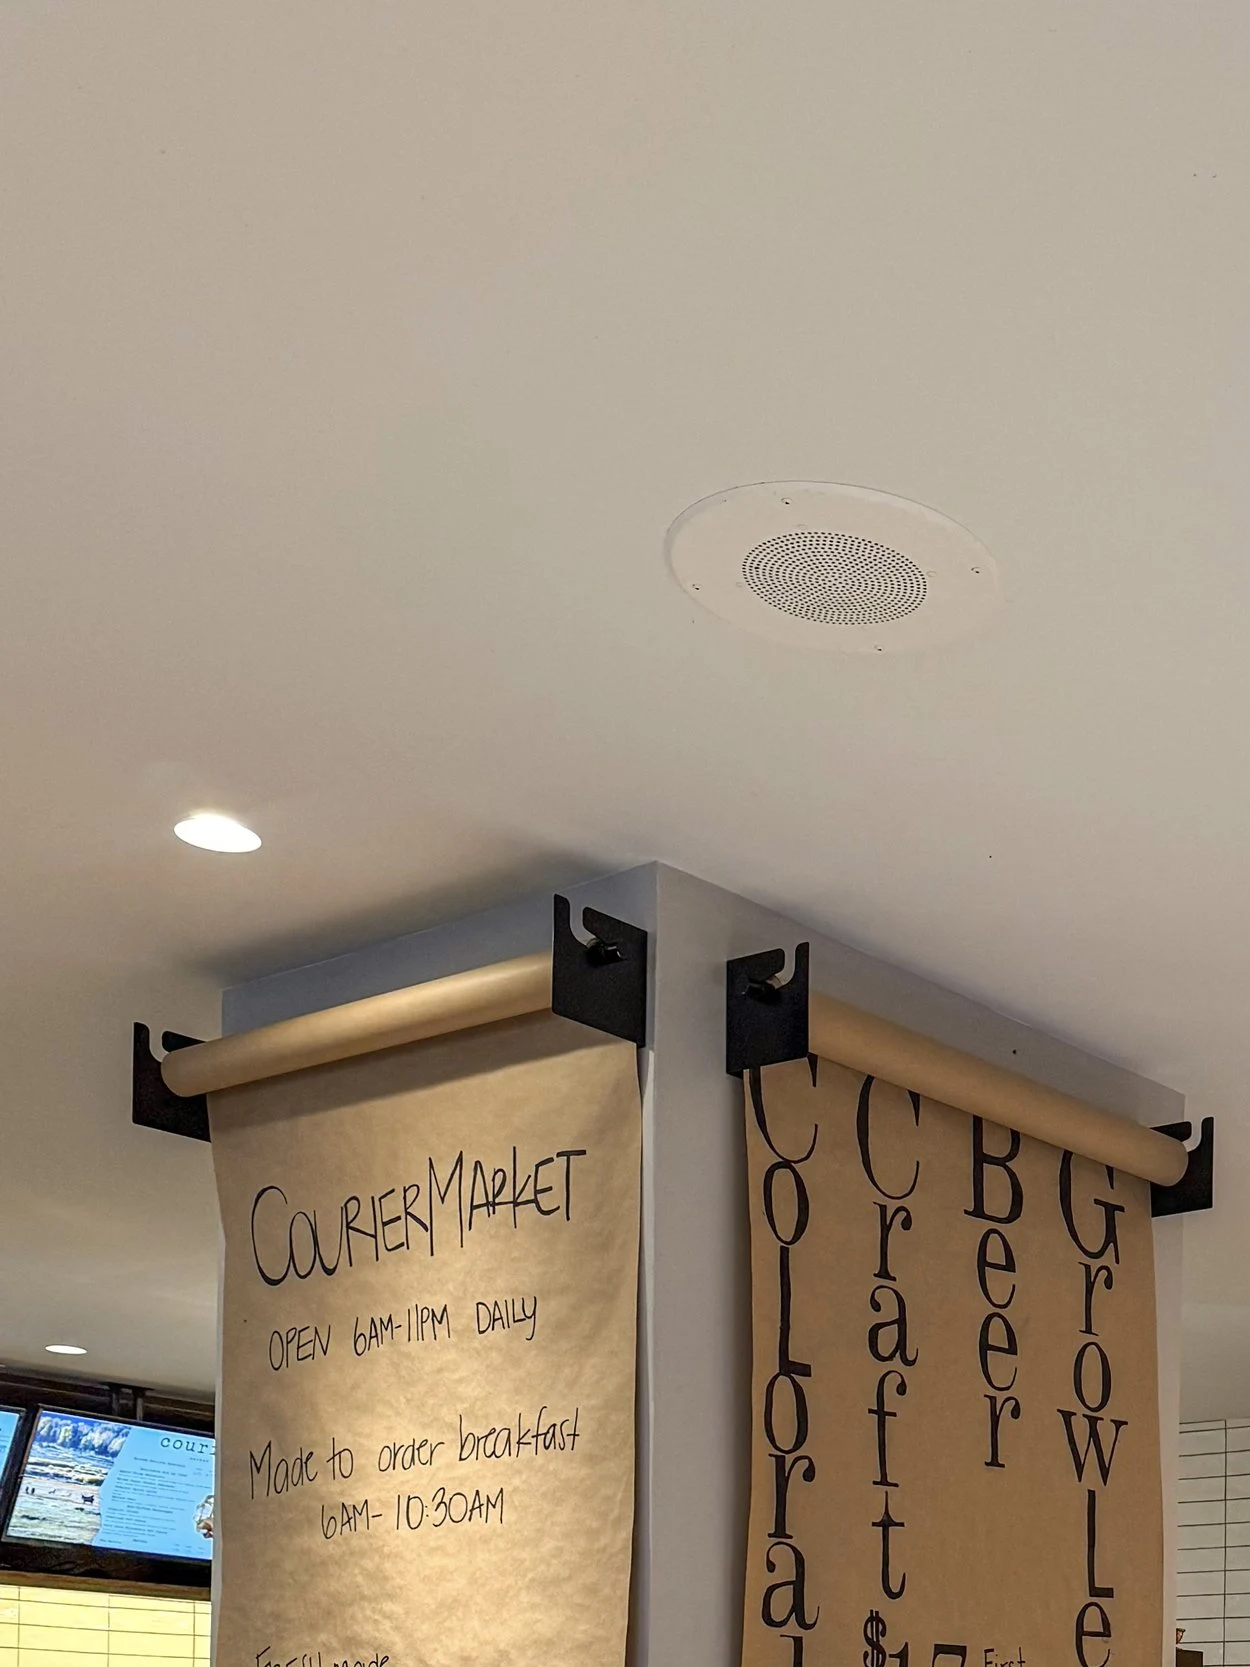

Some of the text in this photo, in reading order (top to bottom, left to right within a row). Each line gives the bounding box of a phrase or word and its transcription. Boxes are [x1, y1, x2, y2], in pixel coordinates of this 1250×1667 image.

[268, 1324, 331, 1371] OPEN
[475, 1296, 538, 1341] DAILY
[856, 1075, 921, 1600] Craft
[963, 1113, 1024, 1468] Beer
[160, 1437, 215, 1456] cour
[249, 1405, 581, 1500] Made to order breakfast
